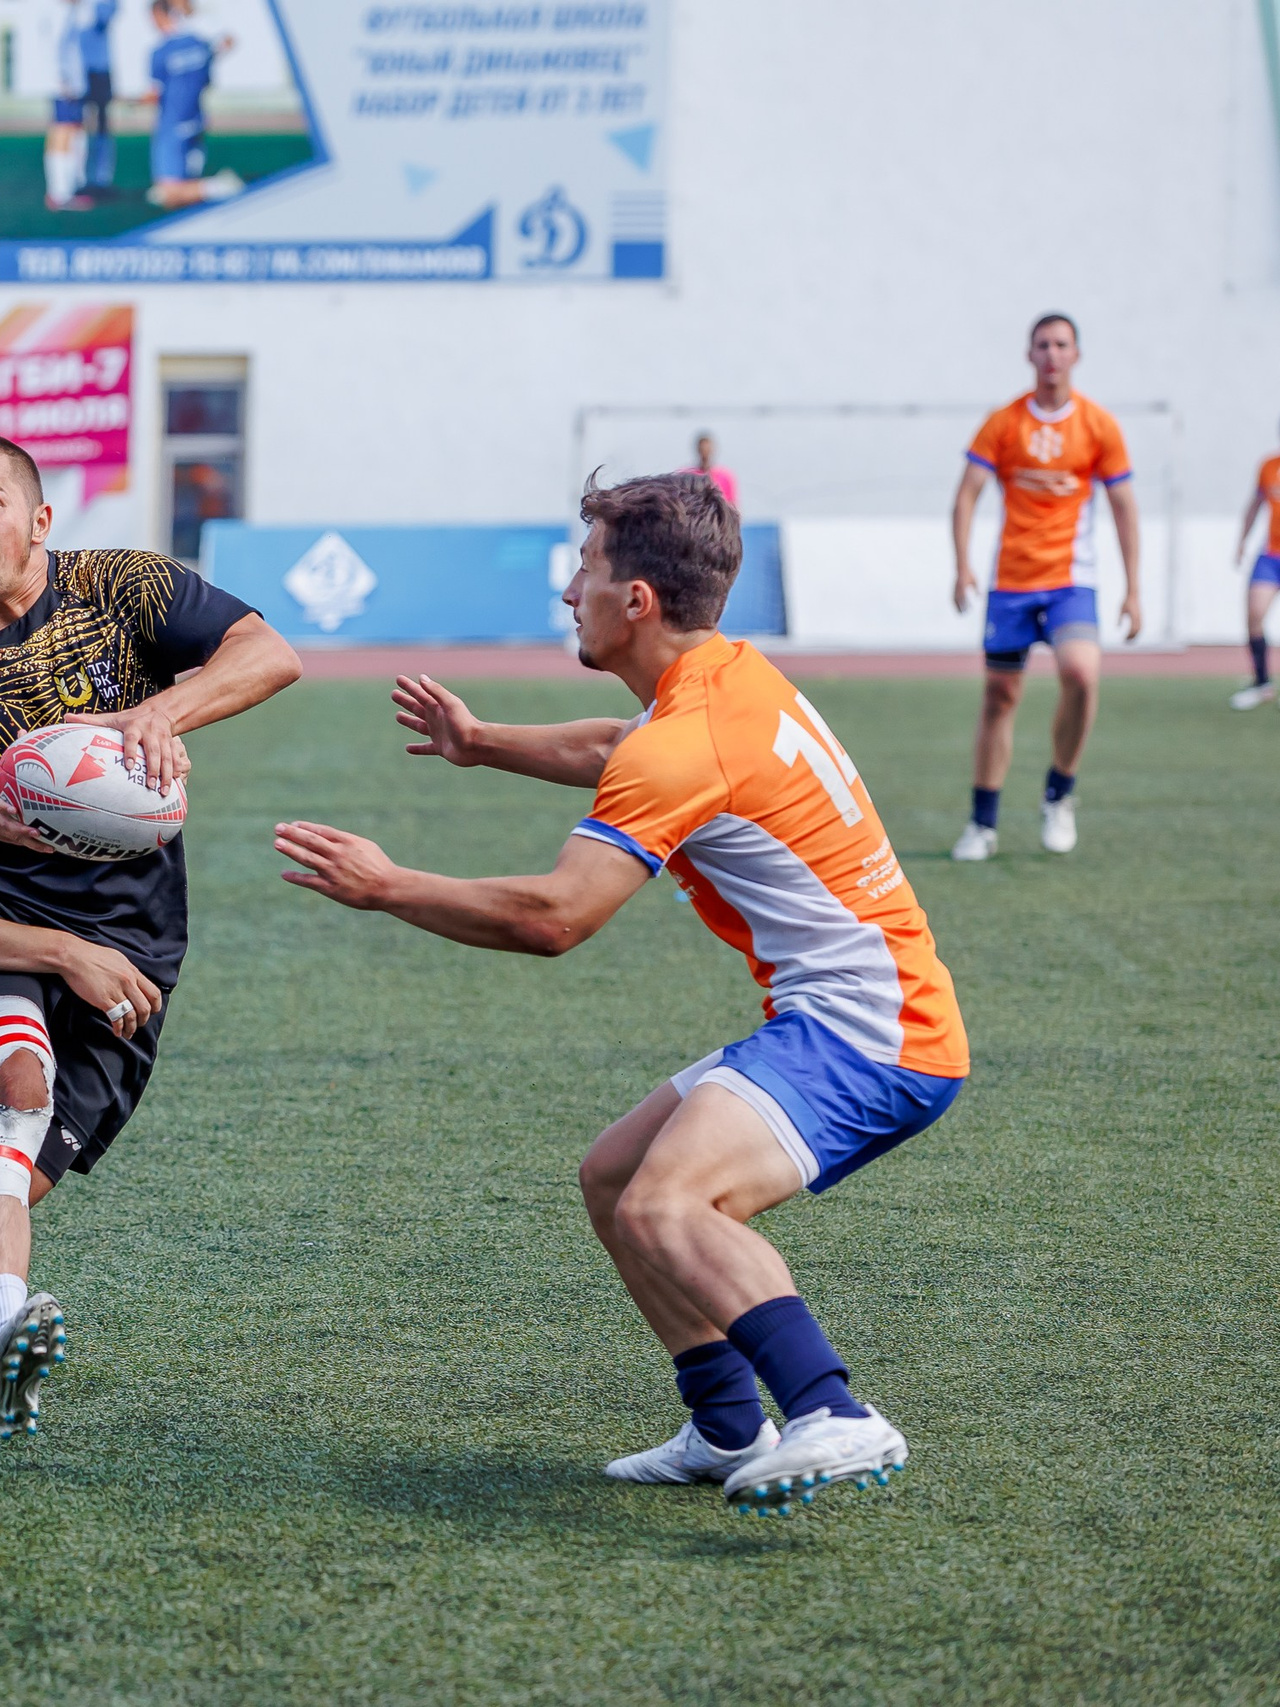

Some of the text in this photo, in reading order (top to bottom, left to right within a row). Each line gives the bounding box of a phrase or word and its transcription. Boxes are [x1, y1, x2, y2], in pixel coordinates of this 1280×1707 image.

[363, 3, 647, 34] ФУТБОЛЬНАЯ ШКОЛА
[354, 89, 441, 117] НАБОР
[446, 86, 529, 119] ДЕТЕЙ
[537, 87, 570, 114] ОТ
[597, 84, 646, 113] ЛЕТ
[19, 393, 129, 437] ИЮЛЯ
[72, 832, 122, 849] METEOR
